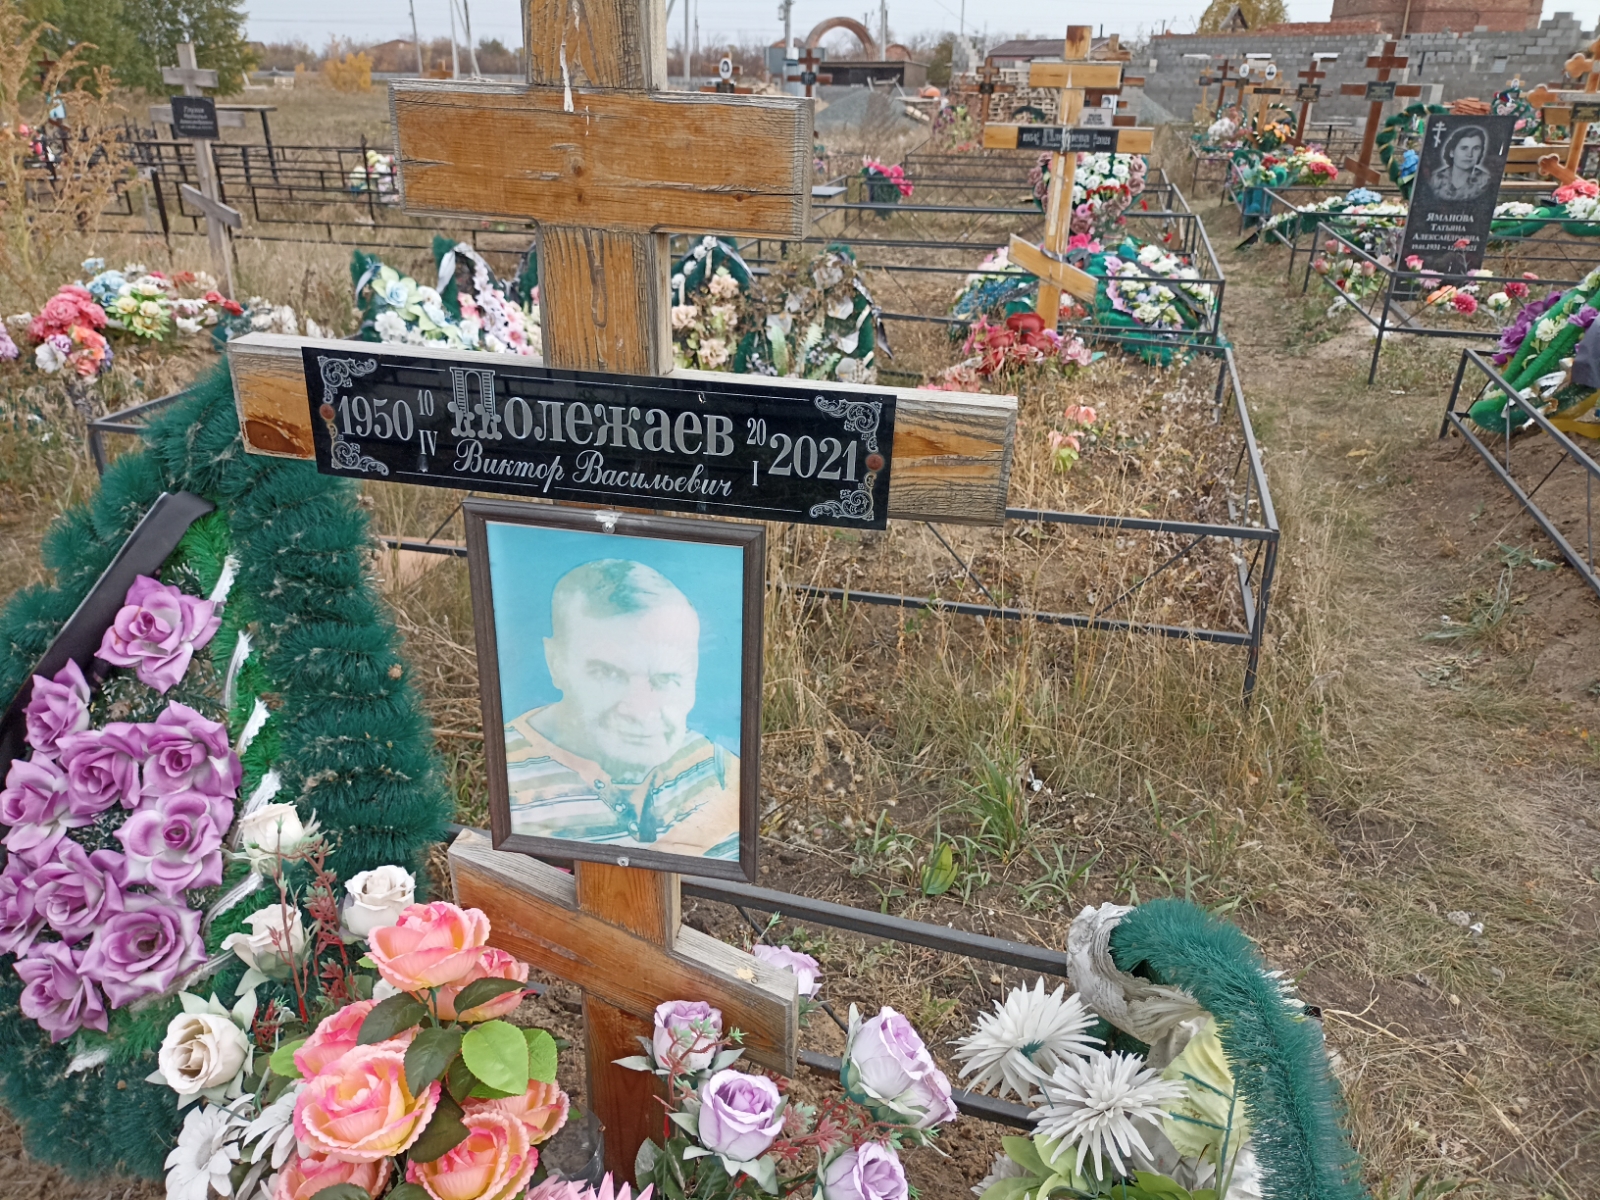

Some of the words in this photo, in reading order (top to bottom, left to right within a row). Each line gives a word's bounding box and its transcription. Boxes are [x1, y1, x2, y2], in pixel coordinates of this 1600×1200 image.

[1426, 212, 1474, 223] ЯМАНОВА
[1431, 223, 1466, 232] ТАТЬЯНА
[338, 396, 413, 440] 1950
[417, 394, 434, 416] 10
[447, 367, 735, 457] Полежаев
[417, 429, 438, 456] IV
[747, 418, 766, 448] 20
[453, 438, 565, 493] Виктор
[571, 449, 733, 496] Васильевич
[767, 432, 859, 482] 2021
[751, 461, 759, 486] I
